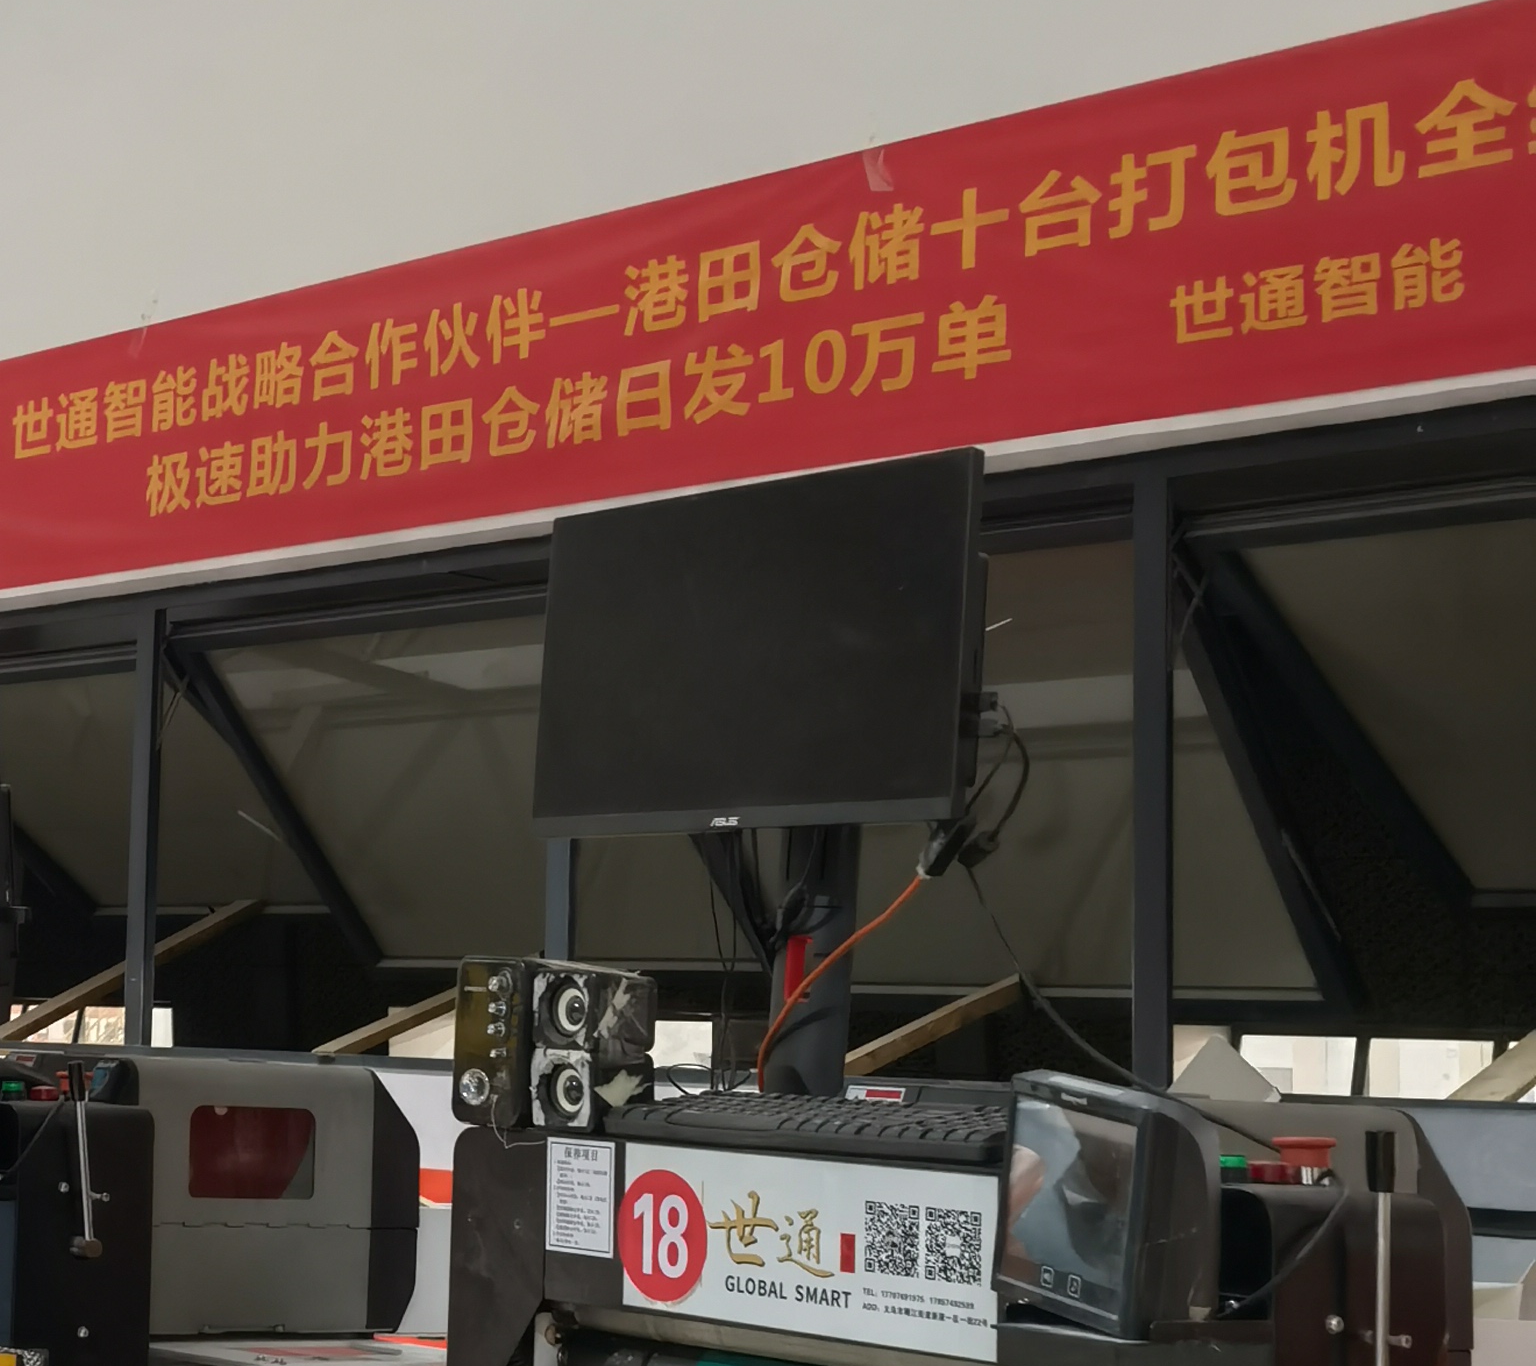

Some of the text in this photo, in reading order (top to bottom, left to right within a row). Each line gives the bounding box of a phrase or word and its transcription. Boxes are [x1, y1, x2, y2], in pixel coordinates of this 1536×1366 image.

[1170, 238, 1464, 345] 世通智能
[146, 294, 1011, 517] 极速助力港田仓储日发10万单
[633, 1193, 689, 1279] 18
[708, 1190, 836, 1278] 世通
[724, 1275, 852, 1309] GLOBAL SMART
